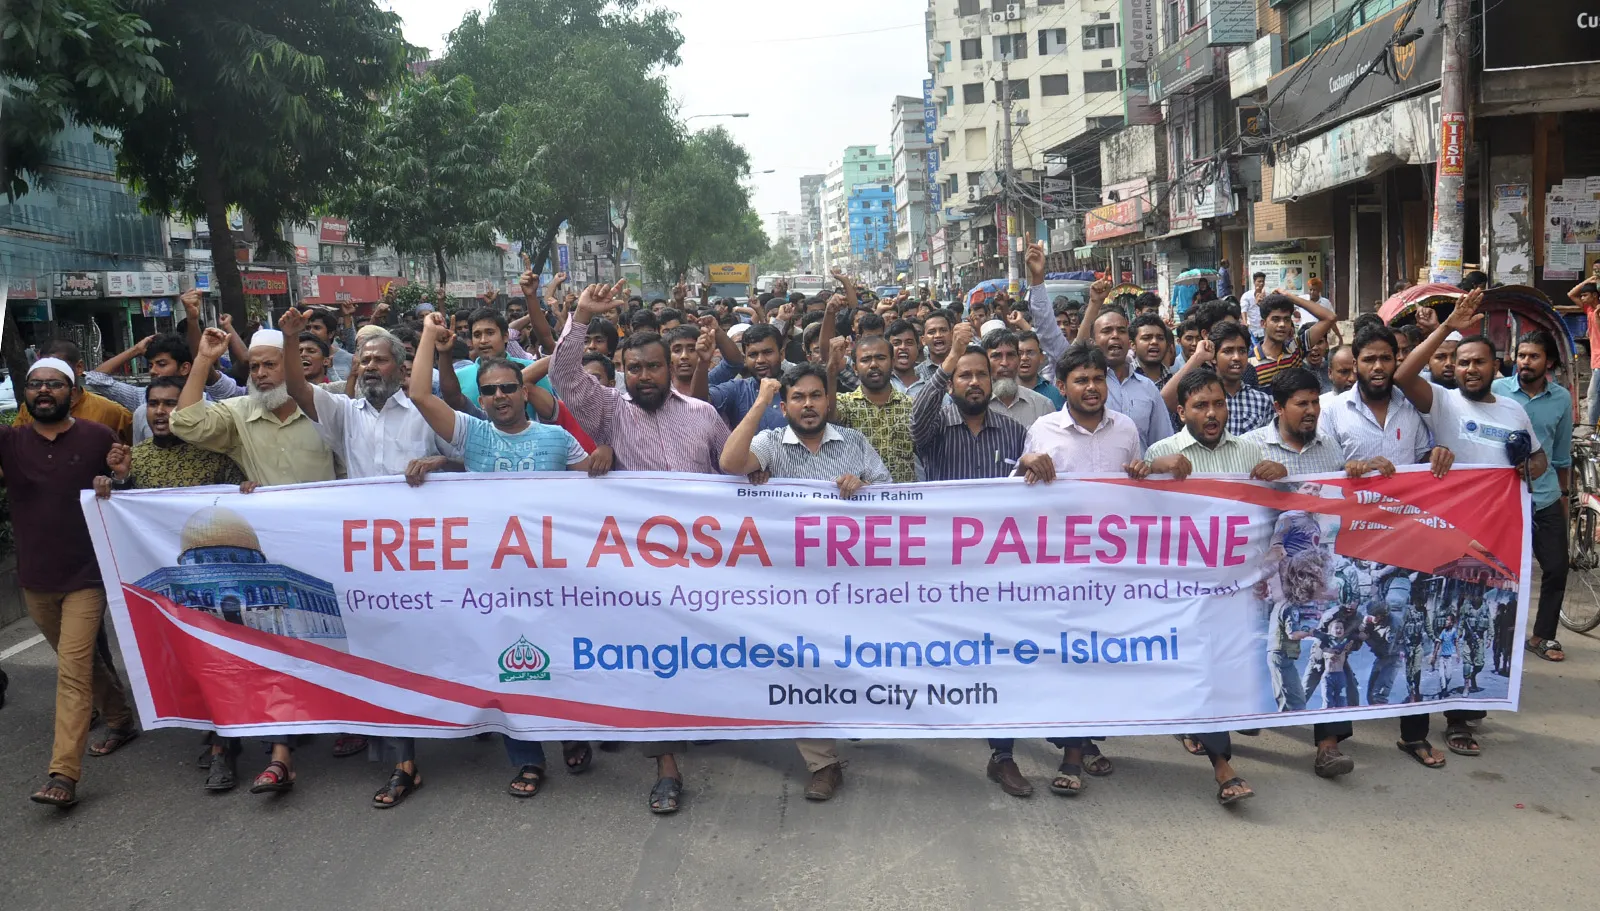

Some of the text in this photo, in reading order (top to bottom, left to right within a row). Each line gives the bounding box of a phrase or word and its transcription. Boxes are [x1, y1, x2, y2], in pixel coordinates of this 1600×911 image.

[1576, 12, 1600, 29] Cu
[1481, 427, 1510, 439] VERSA
[737, 488, 923, 502] Bismillahir Rahanir Rahim
[1353, 489, 1381, 504] The
[342, 513, 1250, 573] FREE AL AQSA FREE PALESTINE
[345, 588, 433, 613] (Protest
[460, 586, 556, 614] Against
[561, 585, 662, 608] Heinous
[669, 582, 808, 612] Aggression
[815, 581, 840, 604] of
[847, 580, 909, 604] Israel
[917, 582, 942, 603] to
[948, 579, 990, 602] the
[998, 578, 1115, 607] Humanity
[1123, 578, 1169, 599] and
[573, 626, 1179, 679] Bangladesh Jamaat-e-Islami
[768, 682, 998, 710] Dhaka City North
